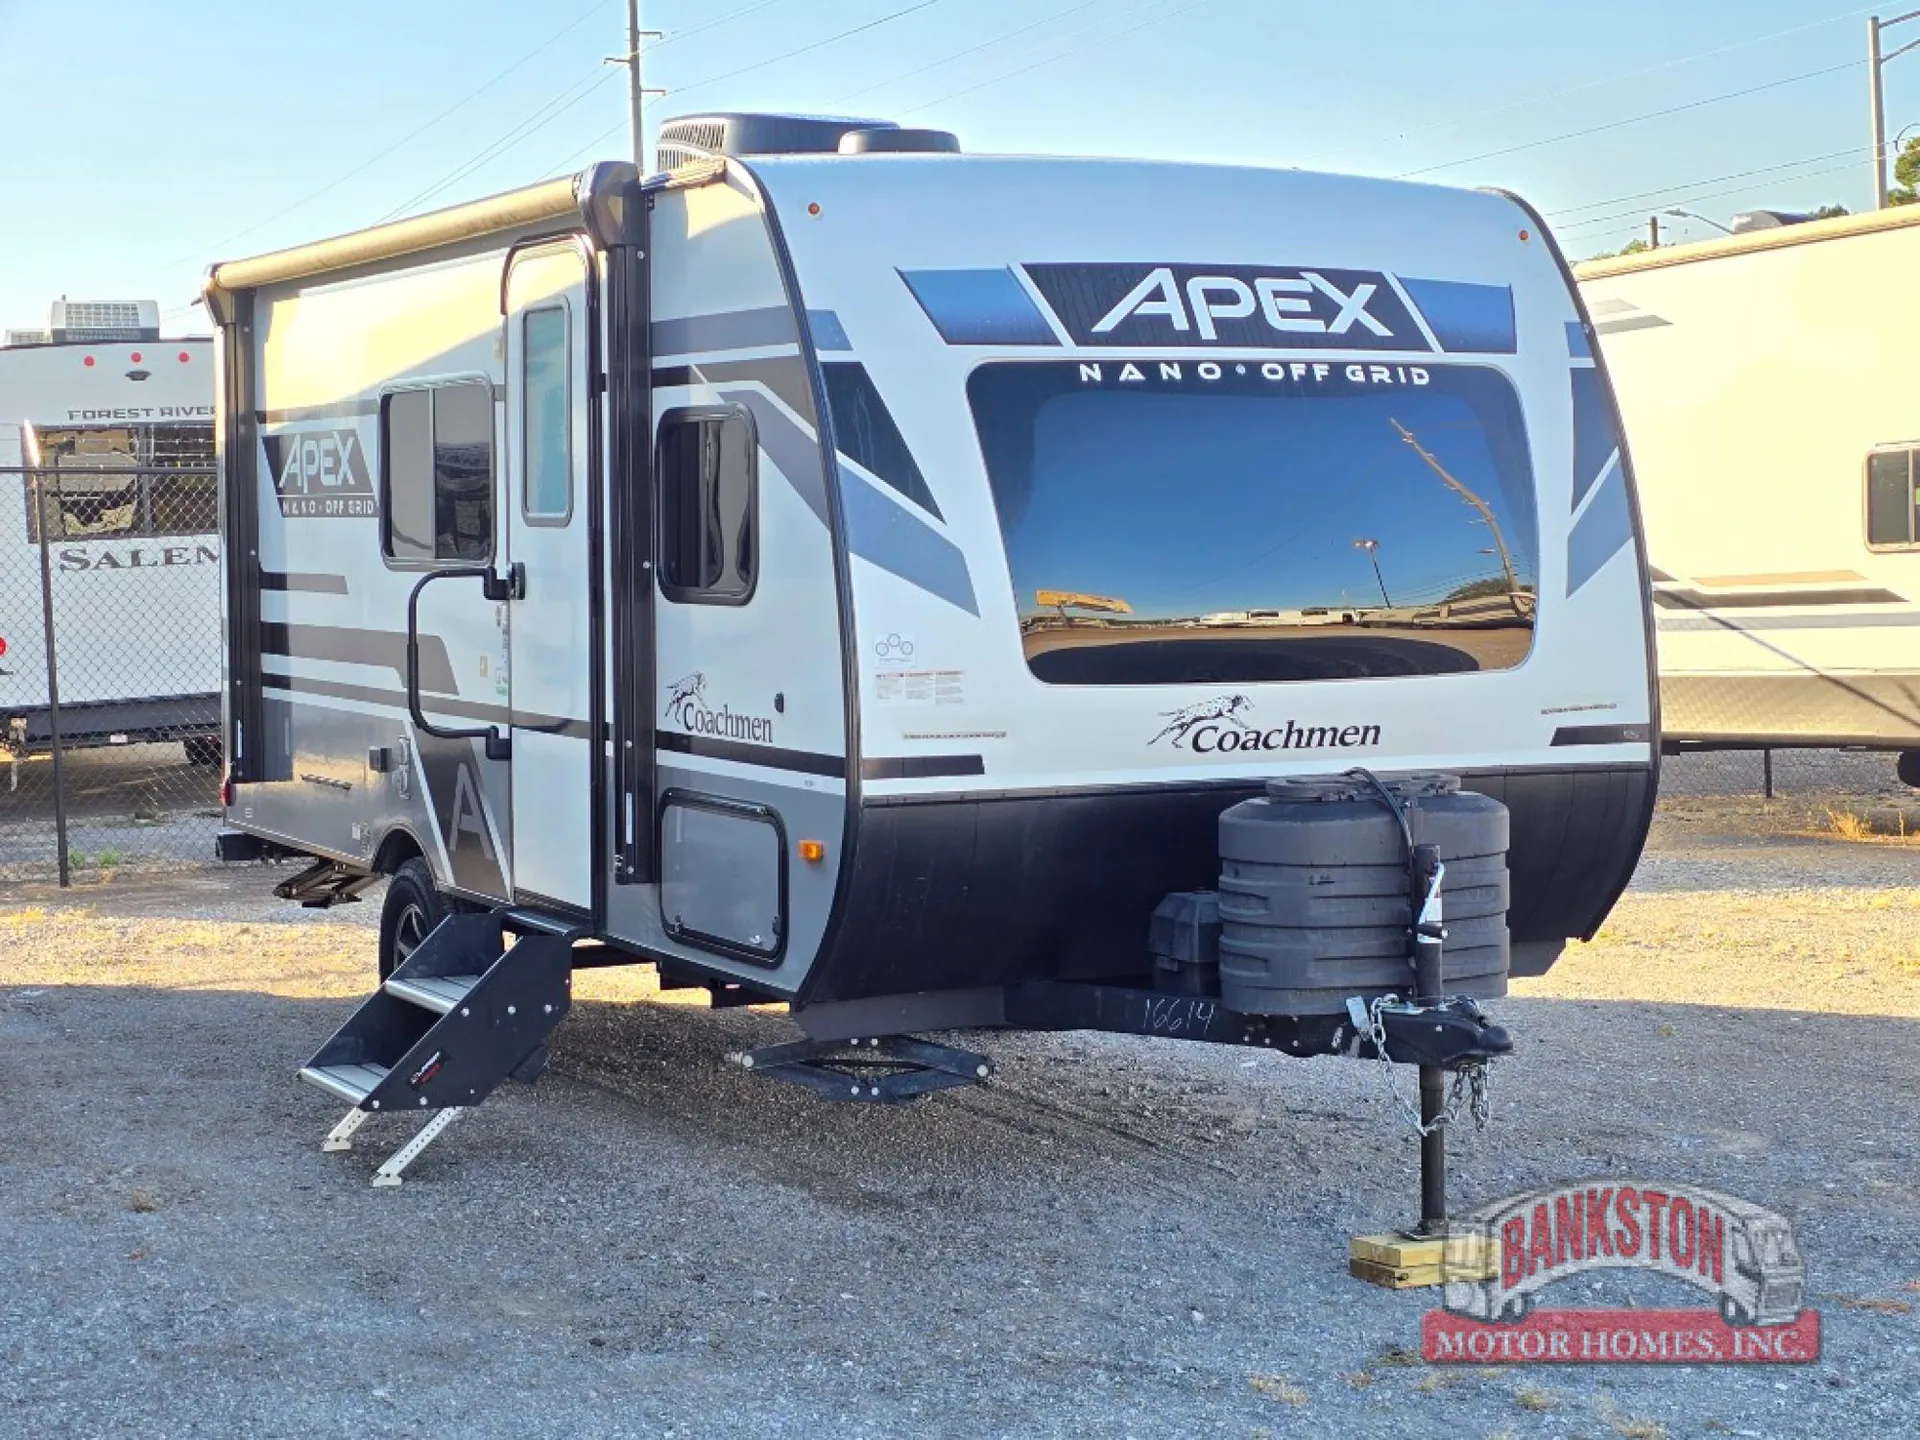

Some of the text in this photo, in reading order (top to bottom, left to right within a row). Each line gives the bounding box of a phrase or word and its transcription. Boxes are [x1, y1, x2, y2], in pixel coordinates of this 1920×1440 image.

[1091, 267, 1394, 339] APEX
[1079, 363, 1430, 385] NANO OFF GRID
[67, 408, 154, 420] FOREST
[279, 430, 355, 493] APEX
[282, 500, 374, 515] NANO OFF GRID
[683, 702, 774, 743] Coachmen
[1191, 719, 1382, 753] Coachmen
[1142, 998, 1217, 1035] 16614
